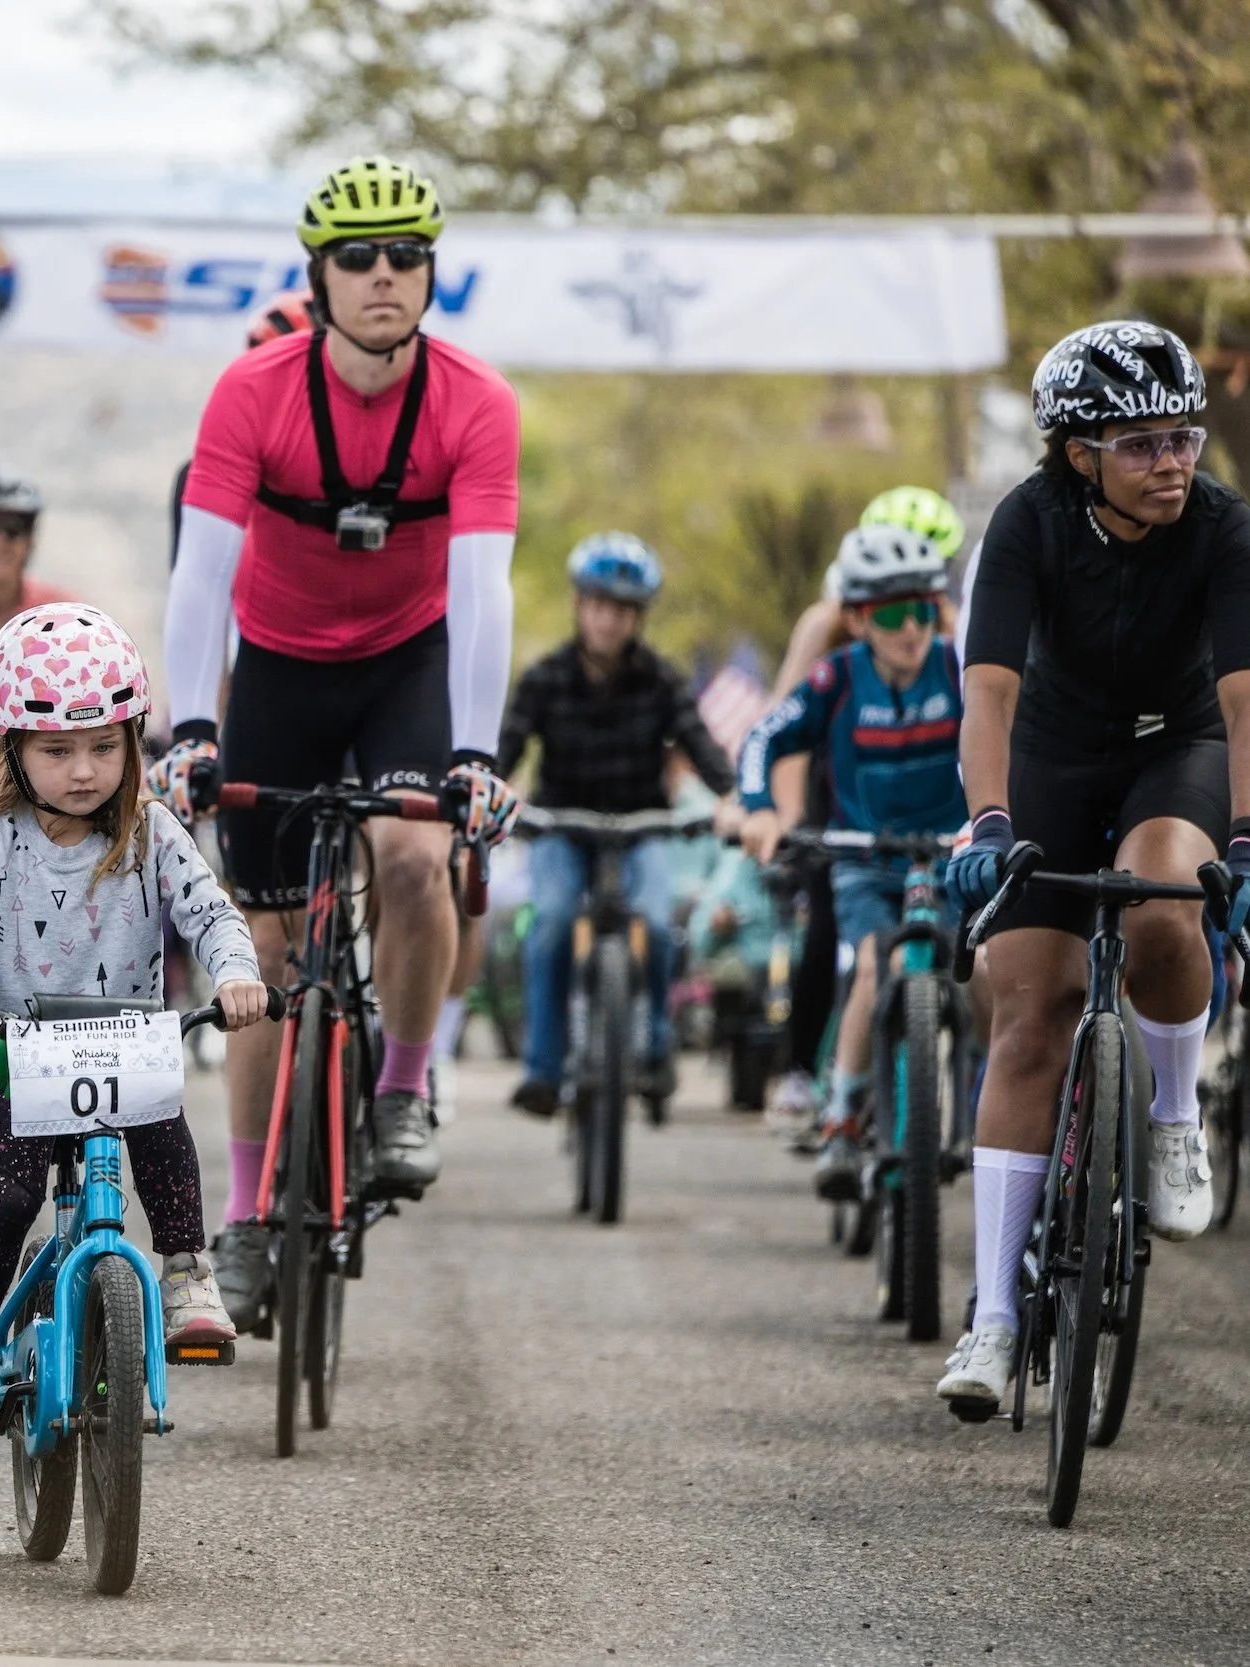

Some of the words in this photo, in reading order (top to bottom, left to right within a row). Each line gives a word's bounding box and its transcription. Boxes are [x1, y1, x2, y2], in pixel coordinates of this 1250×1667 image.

[392, 770, 431, 788] COL
[286, 885, 309, 902] CO
[53, 1018, 136, 1034] SHIMANO
[86, 1032, 108, 1040] FUN
[113, 1031, 138, 1039] RIDE
[72, 1049, 121, 1062] Whiskey
[72, 1060, 122, 1069] Off-Road
[70, 1076, 119, 1118] 01
